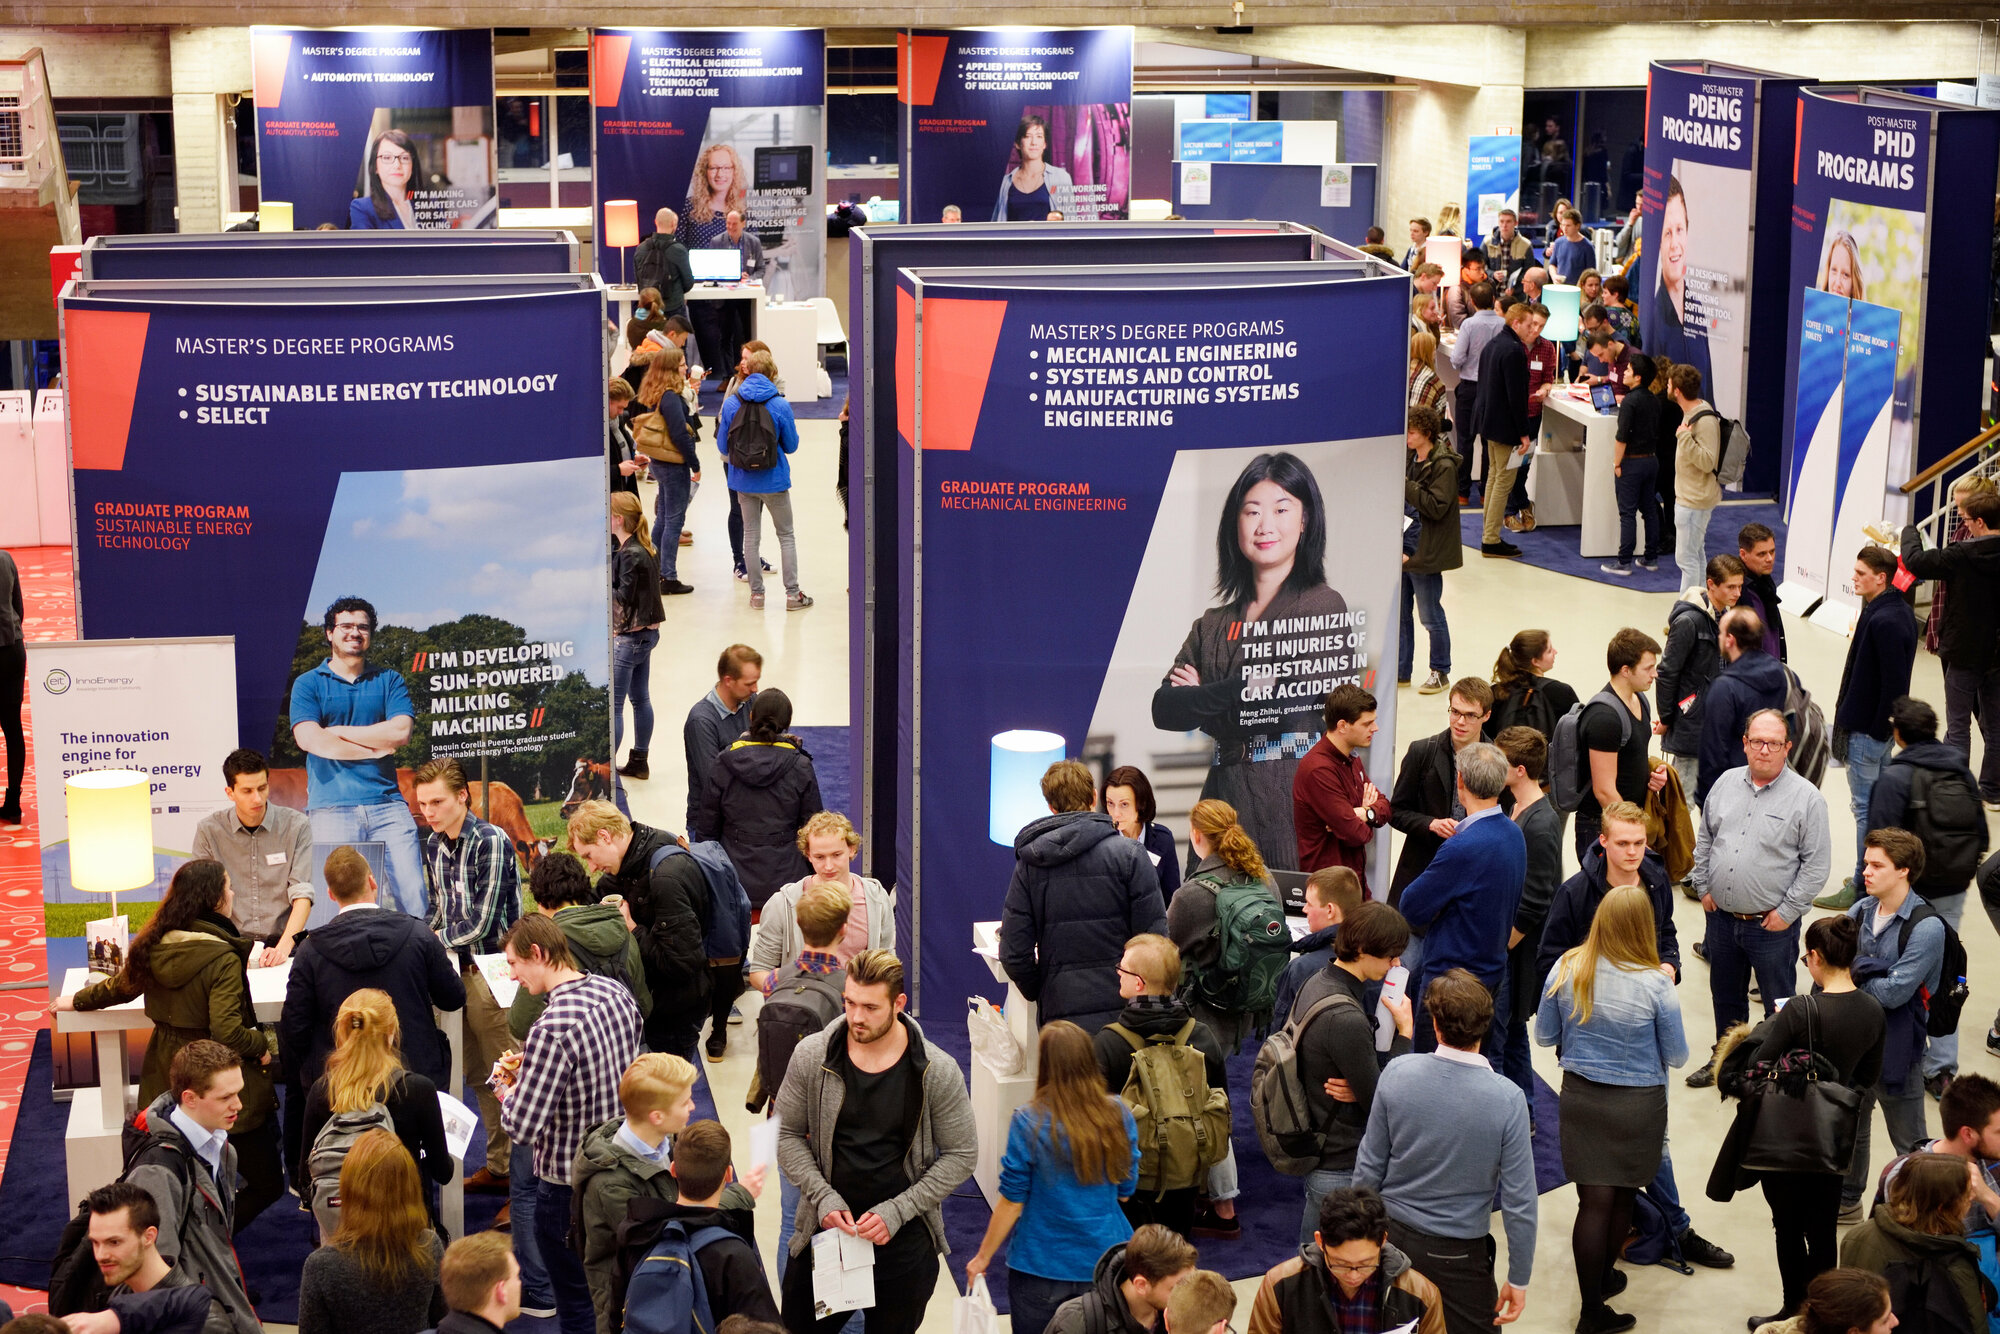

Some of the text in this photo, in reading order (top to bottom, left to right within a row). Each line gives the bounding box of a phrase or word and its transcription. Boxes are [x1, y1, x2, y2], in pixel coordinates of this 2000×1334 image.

[302, 47, 421, 56] MASTER'S DEGREE PROGRAM
[641, 47, 762, 57] MASTER'S DEGREE PROGRAMS
[958, 47, 1074, 56] MASTER'S DEGREE PROGRAMS
[649, 58, 763, 67] ELECTRICAL ENGINEERING
[965, 62, 1042, 71] APPLIED PHYSICS
[311, 72, 434, 82] AUTOMOTIVE TECHNOLOGY
[649, 67, 803, 77] BROADBAND TELECOMMUNICATION
[965, 71, 1080, 81] SCIENCE AND TECHNOLOGY
[649, 77, 709, 87] TECHNOLOGY
[965, 81, 1052, 91] OF NUCLEAR FUSION
[649, 87, 719, 97] CARE AND CURE
[1702, 83, 1744, 97] POST-MASTER
[1688, 93, 1742, 123] PDENG
[265, 121, 336, 129] GRADUATE PROGRAM
[603, 120, 638, 128] GRADUATE
[918, 118, 952, 126] GRADUATE
[918, 125, 973, 134] APPLIED PHYSICS
[1867, 115, 1917, 130] POST-MASTER
[265, 128, 339, 137] AUTOMOTIVE SYSTEMS
[603, 127, 685, 136] ELECTRICAL ENGINEERING
[1662, 115, 1742, 151] PROGRAMS
[1874, 129, 1916, 158] PHD
[1817, 149, 1915, 191] PROGRAMS
[414, 189, 464, 199] I'M MAKING
[746, 187, 807, 197] I'M IMPROVING
[1056, 184, 1107, 193] I'M WORKING
[414, 199, 478, 210] SMARTER CARS
[746, 198, 797, 208] HEALTHCARE
[1056, 194, 1107, 203] ON BRINGING
[414, 210, 459, 220] FOR SAFER
[746, 208, 808, 218] TROUGH IMAGE
[1057, 203, 1119, 213] NUCLEAR FUSION
[415, 221, 450, 229] CYCLING
[746, 219, 798, 228] PROCESSING
[1695, 268, 1728, 283] DESIGNING
[1690, 279, 1711, 291] STOCK-
[1684, 289, 1719, 306] OPTIMISING
[1684, 301, 1732, 320] SOFTWARE TOOL
[1684, 313, 1695, 323] FOR
[1029, 319, 1284, 340] MASTER'S DEGREE PROGRAMS
[1805, 319, 1822, 331] COFFEE
[1825, 324, 1834, 335] TEA
[1805, 330, 1823, 343] TOILETS
[1852, 331, 1889, 349] LECTURE ROOMS
[175, 334, 454, 355] MASTER'S DEGREE PROGRAMS
[1046, 341, 1298, 364] MECHANICAL ENGINEERING
[1046, 363, 1273, 385] SYSTEMS AND CONTROL
[195, 373, 558, 402] SUSTAINABLE ENERGY TECHNOLOGY
[1044, 382, 1300, 406] MANUFACTURING SYSTEMS
[196, 406, 270, 425] SELECT
[1044, 409, 1173, 427] ENGINEERING
[940, 480, 1090, 496] GRADUATE PROGRAM
[94, 502, 250, 519] GRADUATE PROGRAM
[940, 496, 1127, 511] MECHANICAL ENGINEERING
[95, 518, 253, 535] SUSTAINABLE ENERGY
[96, 534, 191, 550] TECHNOLOGY
[1242, 610, 1366, 638] I'M MINIMIZING
[1241, 631, 1367, 659] THE INJURIES OF
[428, 640, 574, 669] I'M DEVELOPING
[1241, 652, 1368, 681] PEDESTRAINS IN
[49, 676, 134, 686] eit InnoEnergy
[429, 664, 564, 692] SUN-POWERED
[1240, 685, 1274, 703] CAR
[430, 692, 510, 714] MILKING
[1239, 710, 1259, 718] Meng
[1259, 706, 1283, 716] Zhihui,
[1283, 703, 1313, 714] graduate
[431, 712, 527, 737] MACHINES
[1239, 716, 1279, 727] Engineering
[60, 729, 170, 745] The innovation
[431, 730, 576, 753] Joaquin Corella Puente, graduate student
[62, 747, 136, 765] engine for
[431, 743, 544, 760] Sustainable Energy Technology
[151, 764, 202, 778] energy
